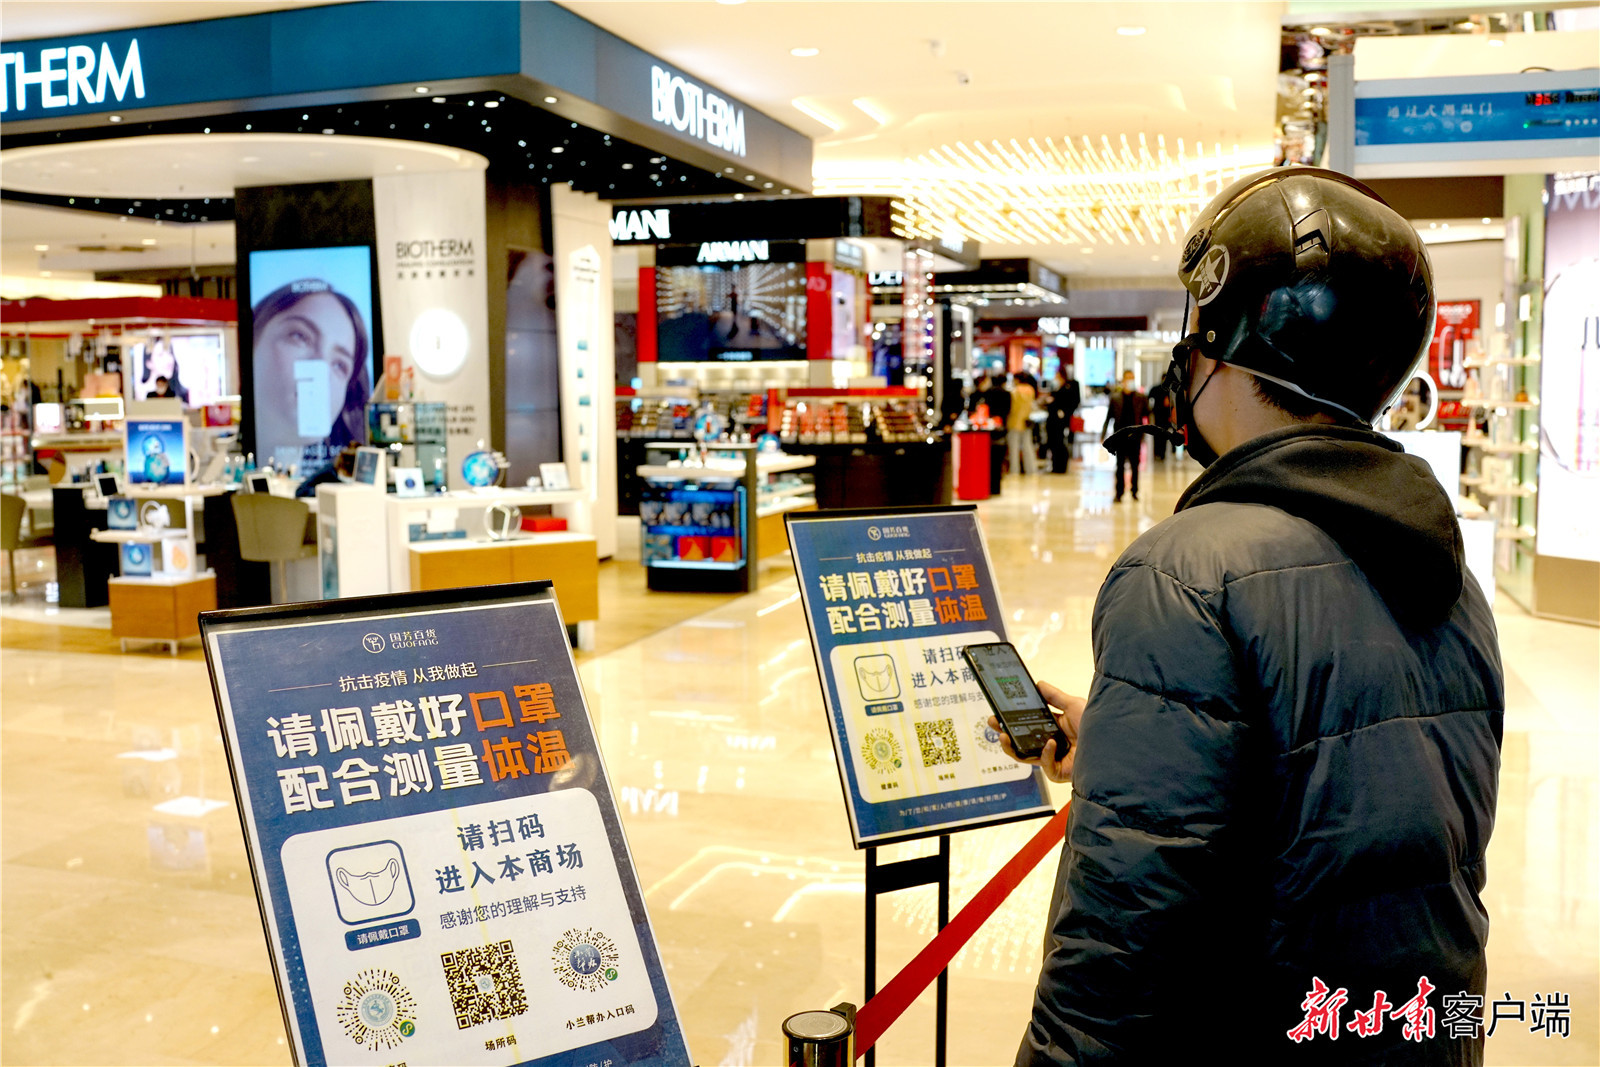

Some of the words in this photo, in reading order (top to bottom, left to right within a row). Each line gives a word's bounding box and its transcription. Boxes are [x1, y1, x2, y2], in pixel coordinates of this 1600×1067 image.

[651, 65, 746, 157] BIOTHERM
[396, 239, 474, 258] BIOTHERM
[696, 240, 769, 263] ARMANI
[856, 550, 894, 564] 抗击疫情
[896, 548, 932, 562] 从我做起
[819, 564, 979, 602] 请佩戴好口罩
[826, 594, 988, 635] 配合测量体温
[389, 629, 437, 642] 国芳百货
[392, 638, 439, 650] GUOFANG
[339, 669, 408, 692] 抗击疫情
[413, 661, 478, 684] 从我做起
[266, 682, 562, 760] 请佩戴好口罩
[276, 730, 574, 815] 配合测量体温
[456, 813, 545, 851] 请扫码
[435, 842, 585, 895] 进入本商场
[439, 884, 587, 929] 感谢您的理解与支持
[356, 925, 411, 946] 请佩戴口罩
[565, 1003, 636, 1030] 小兰帮办入口码
[484, 1034, 518, 1052] 场所码
